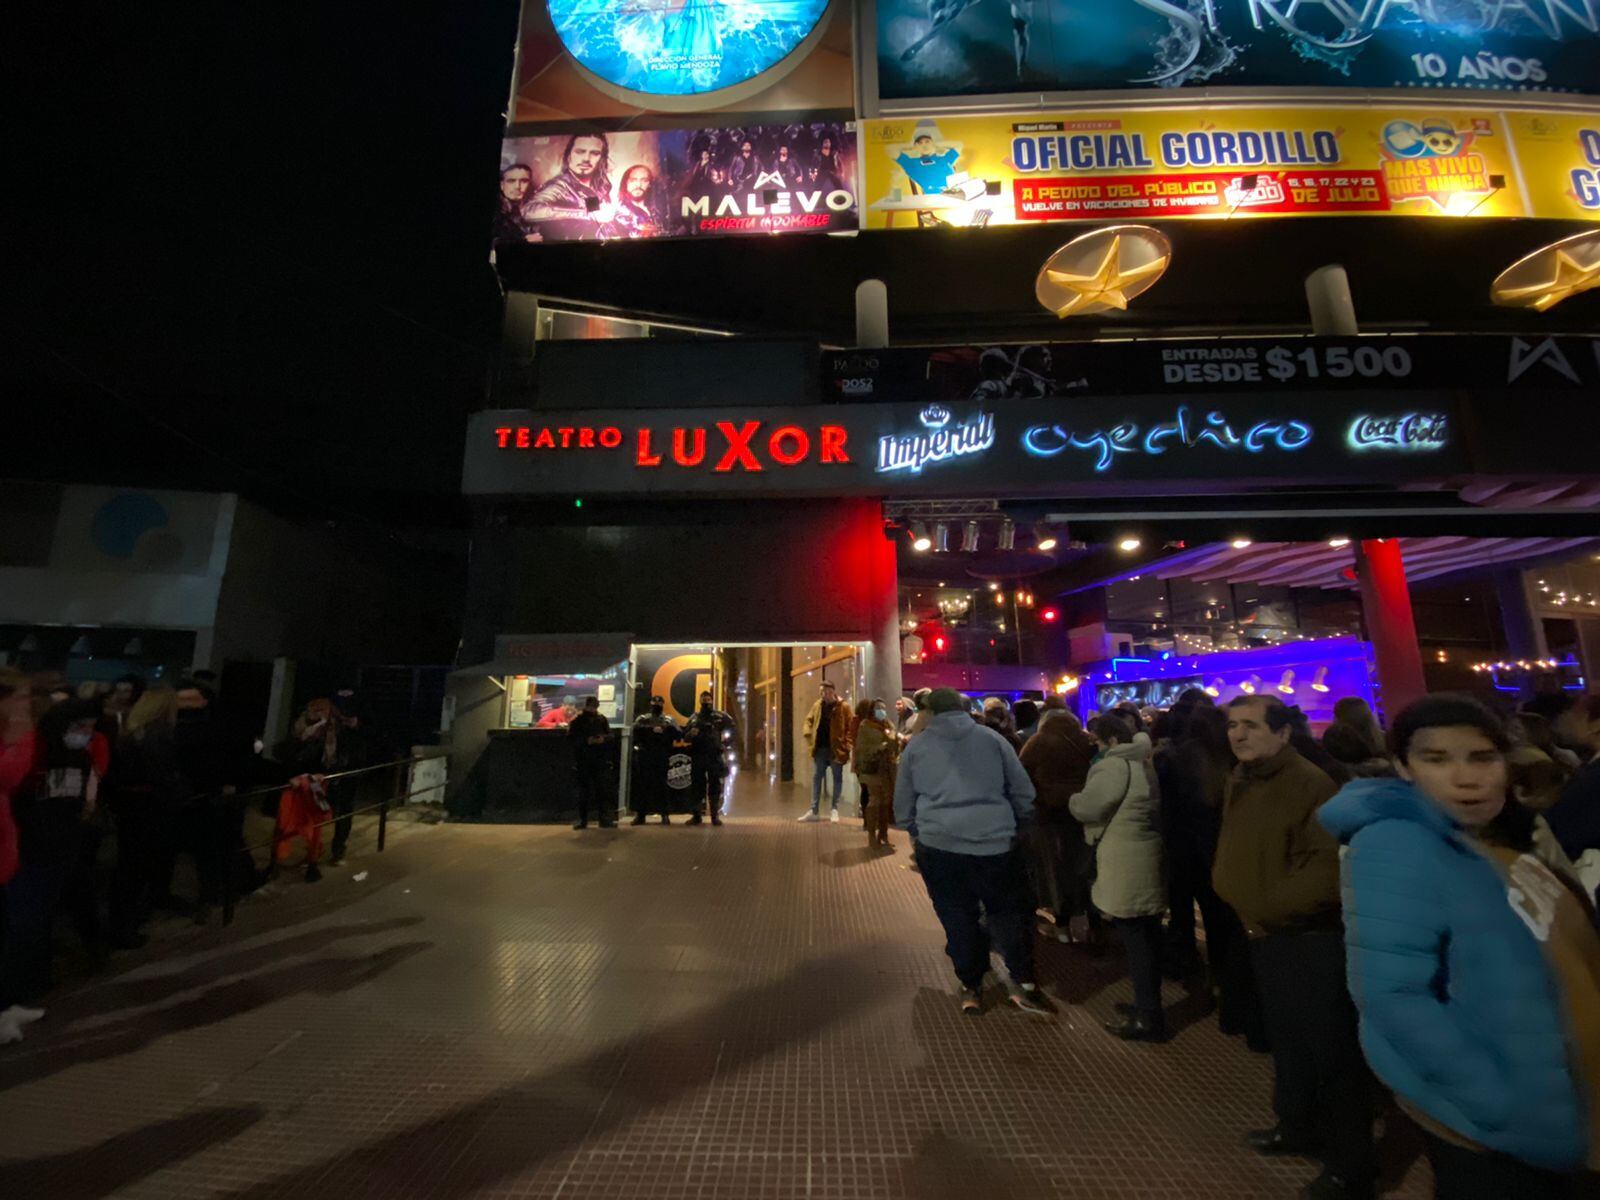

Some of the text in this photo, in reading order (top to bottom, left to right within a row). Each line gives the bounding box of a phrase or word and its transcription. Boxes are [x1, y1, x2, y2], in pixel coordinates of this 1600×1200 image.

[1411, 51, 1548, 82] 10 AÑOS
[1012, 132, 1340, 171] OFICIAL GORDILLO
[1434, 156, 1483, 175] VIVO
[1022, 188, 1033, 200] A
[1039, 186, 1101, 199] PEDIDO
[1106, 184, 1140, 198] DEL
[1145, 180, 1216, 196] PÚBLICO
[1291, 188, 1320, 203] DE
[1326, 187, 1380, 203] JULIO
[1387, 174, 1487, 196] QUE NUNCA
[682, 190, 854, 217] MALEVO
[1022, 201, 1063, 212] VUELVE
[1066, 201, 1080, 210] EN
[1083, 199, 1149, 209] VACACIONES
[1153, 198, 1168, 207] DE
[760, 214, 831, 228] INDOMABLE
[1162, 347, 1257, 361] ENTRADAS
[1164, 345, 1412, 383] DESDE $1500
[496, 421, 850, 472] TEATRO LUXOR
[876, 411, 996, 473] Imperial
